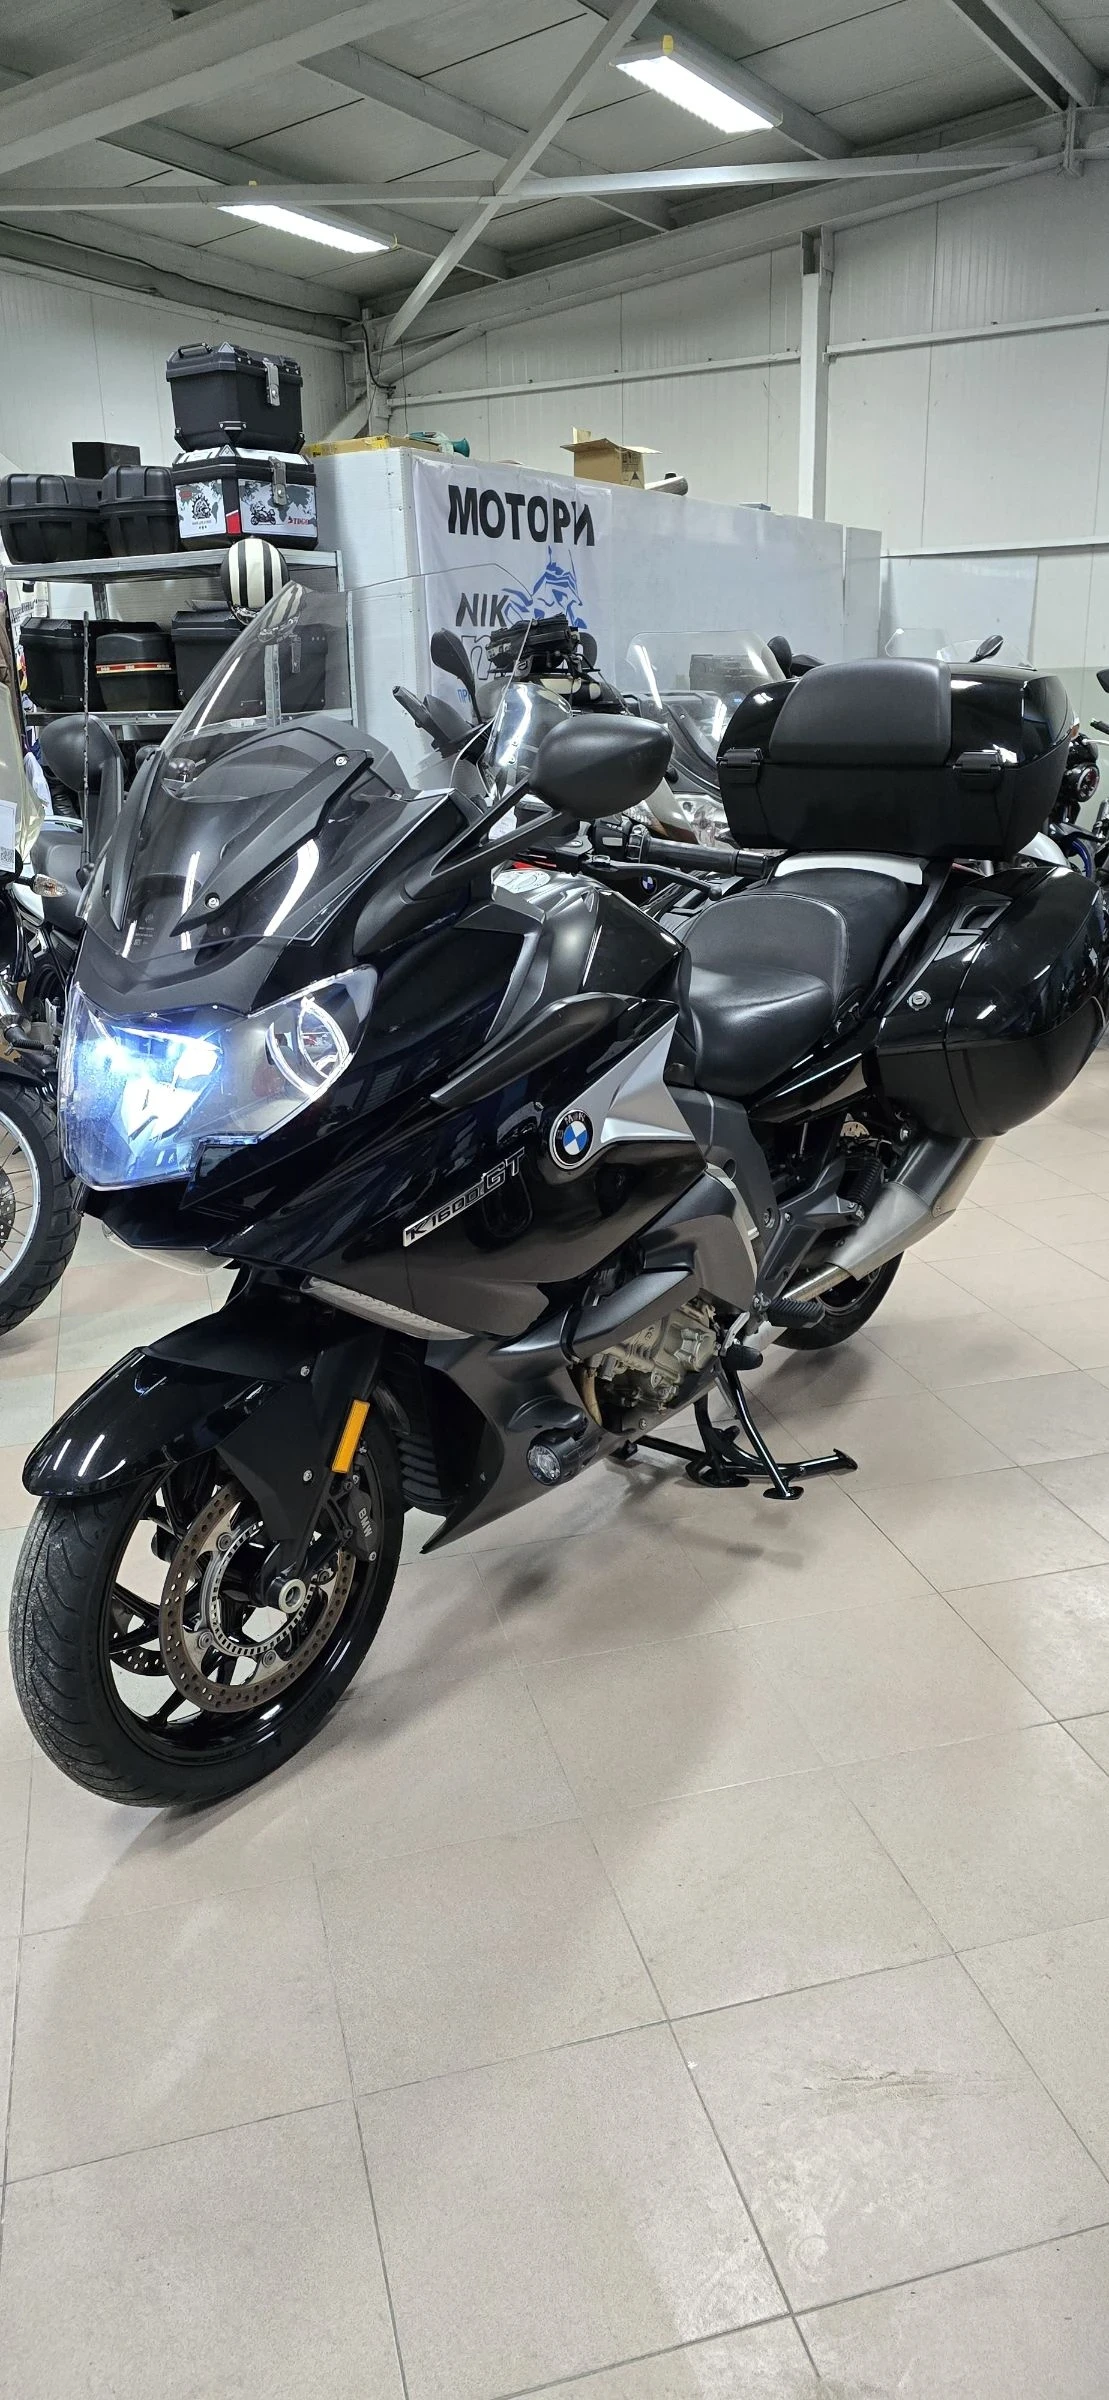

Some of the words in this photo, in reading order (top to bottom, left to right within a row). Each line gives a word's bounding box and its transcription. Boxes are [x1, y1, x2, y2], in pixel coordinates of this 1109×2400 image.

[447, 485, 595, 547] МОТОРИ
[455, 592, 509, 628] NIK
[358, 1507, 373, 1538] BMW
